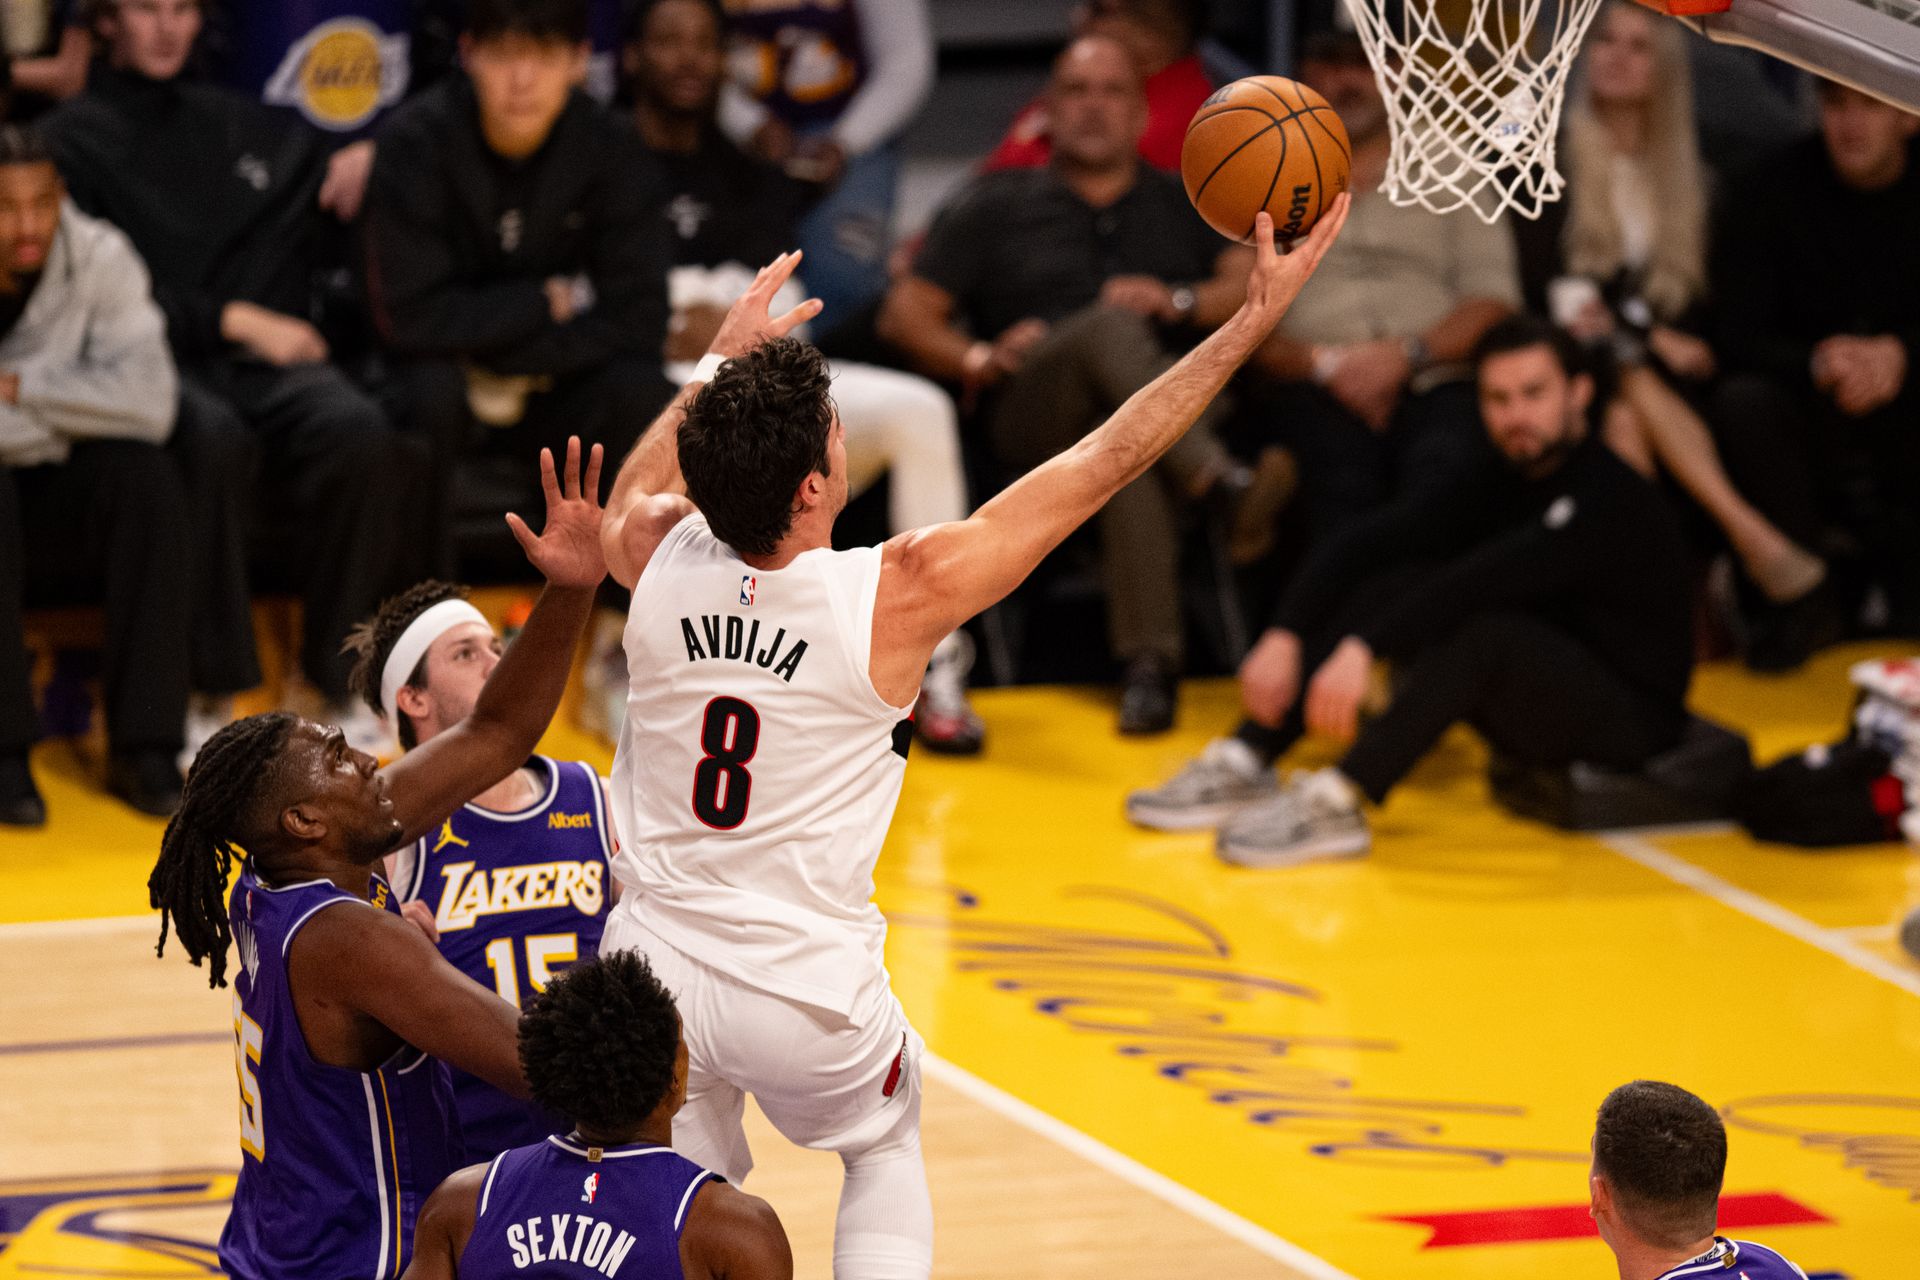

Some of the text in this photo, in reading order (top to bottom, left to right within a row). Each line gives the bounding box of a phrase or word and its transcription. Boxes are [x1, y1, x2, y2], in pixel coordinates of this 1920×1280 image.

[680, 614, 809, 683] AVDIJA
[691, 695, 761, 831] 8
[548, 811, 592, 829] Albert
[434, 860, 604, 934] LAKERS
[506, 1213, 637, 1279] SEXTON
